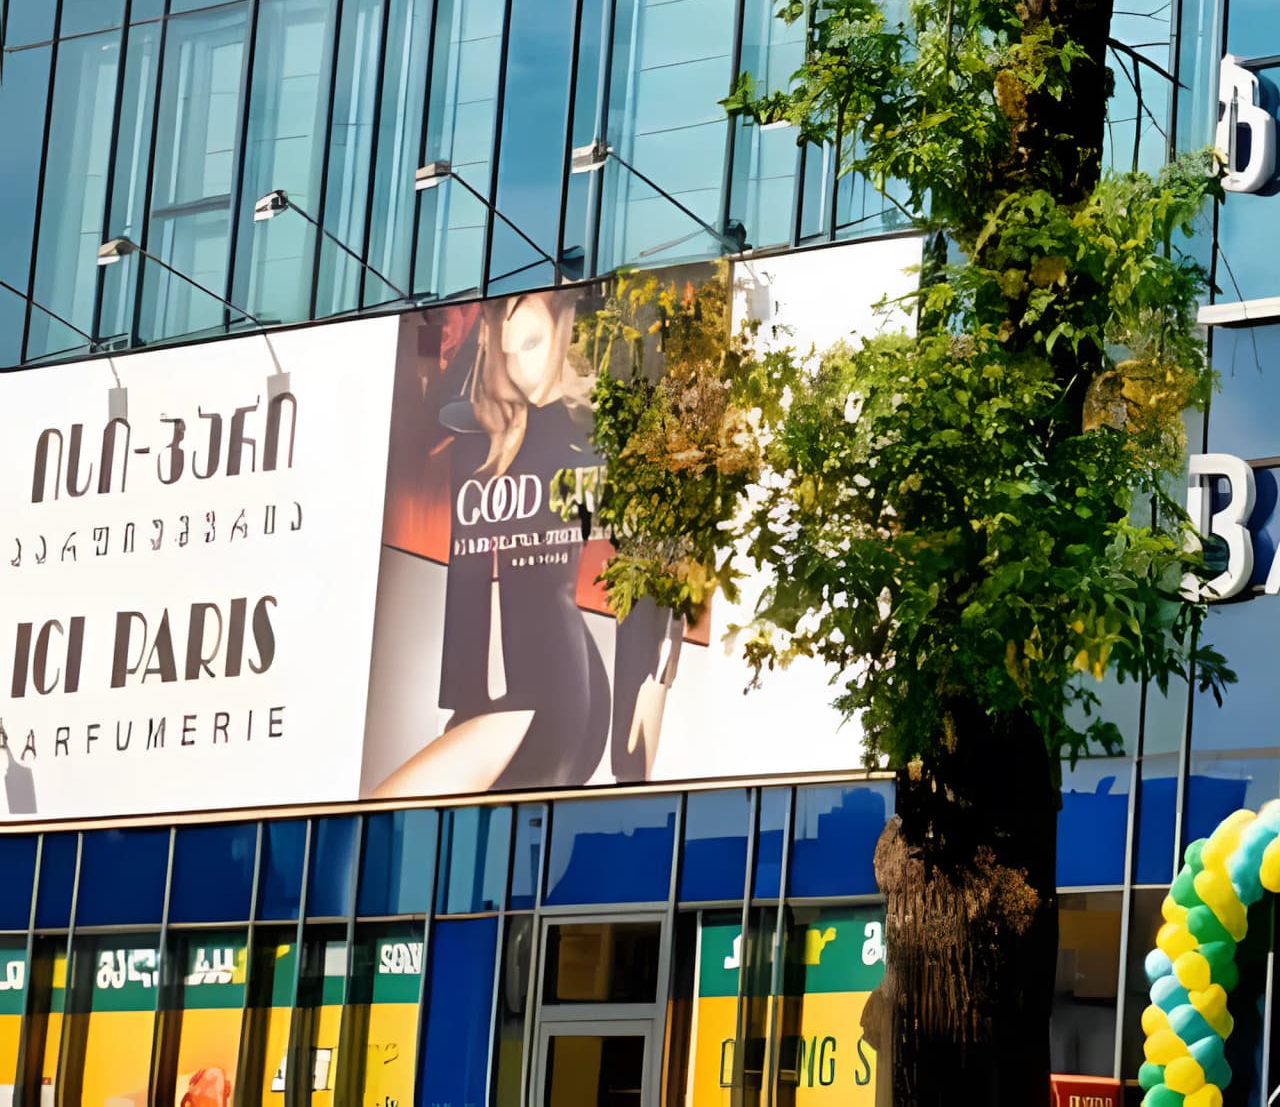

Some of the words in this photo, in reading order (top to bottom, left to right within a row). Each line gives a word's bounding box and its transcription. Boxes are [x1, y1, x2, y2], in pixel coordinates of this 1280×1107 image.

[456, 474, 542, 525] GOOD
[11, 615, 86, 698] ICI
[110, 594, 278, 689] PARIS
